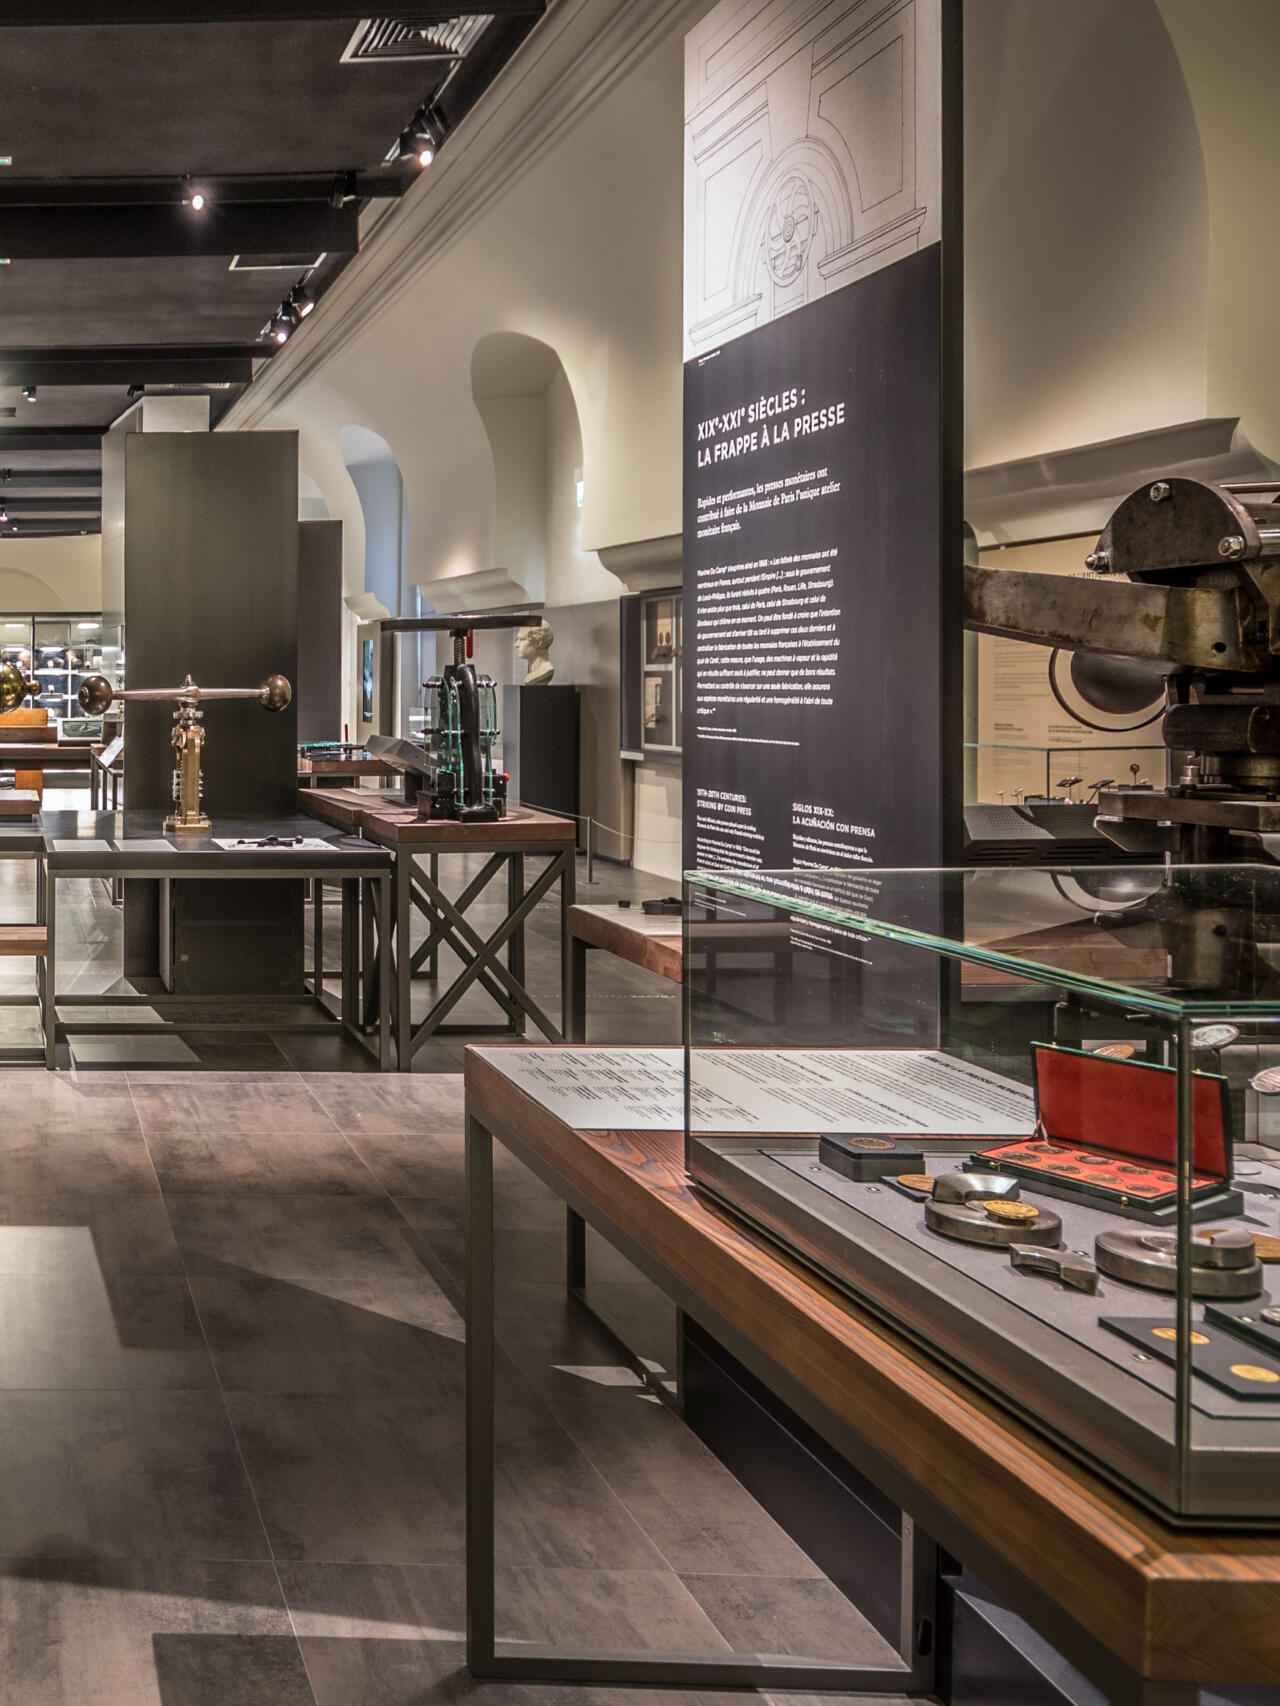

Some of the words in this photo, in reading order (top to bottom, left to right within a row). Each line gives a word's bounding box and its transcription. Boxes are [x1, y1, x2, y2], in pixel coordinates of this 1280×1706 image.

[747, 388, 798, 423] SIÈCLES
[697, 447, 712, 468] LA
[714, 431, 758, 463] FRAPPE
[760, 423, 770, 448] À
[773, 421, 790, 444] LA
[793, 402, 845, 438] PRESSE
[764, 479, 784, 495] presses
[784, 469, 816, 487] monétaires
[816, 467, 828, 479] ont
[772, 494, 780, 506] de
[780, 490, 795, 505] Paris
[795, 486, 820, 501] l'unique
[820, 480, 841, 496] atelier
[717, 802, 724, 811] BY
[724, 803, 736, 813] COIN
[736, 805, 752, 816] PRESS
[719, 791, 747, 803] CENTURIES:
[792, 802, 812, 814] SIGLOS
[792, 815, 801, 825] LA
[800, 816, 835, 831] ACUÑACIÓN
[835, 822, 849, 833] CON
[850, 824, 875, 838] PRENSA
